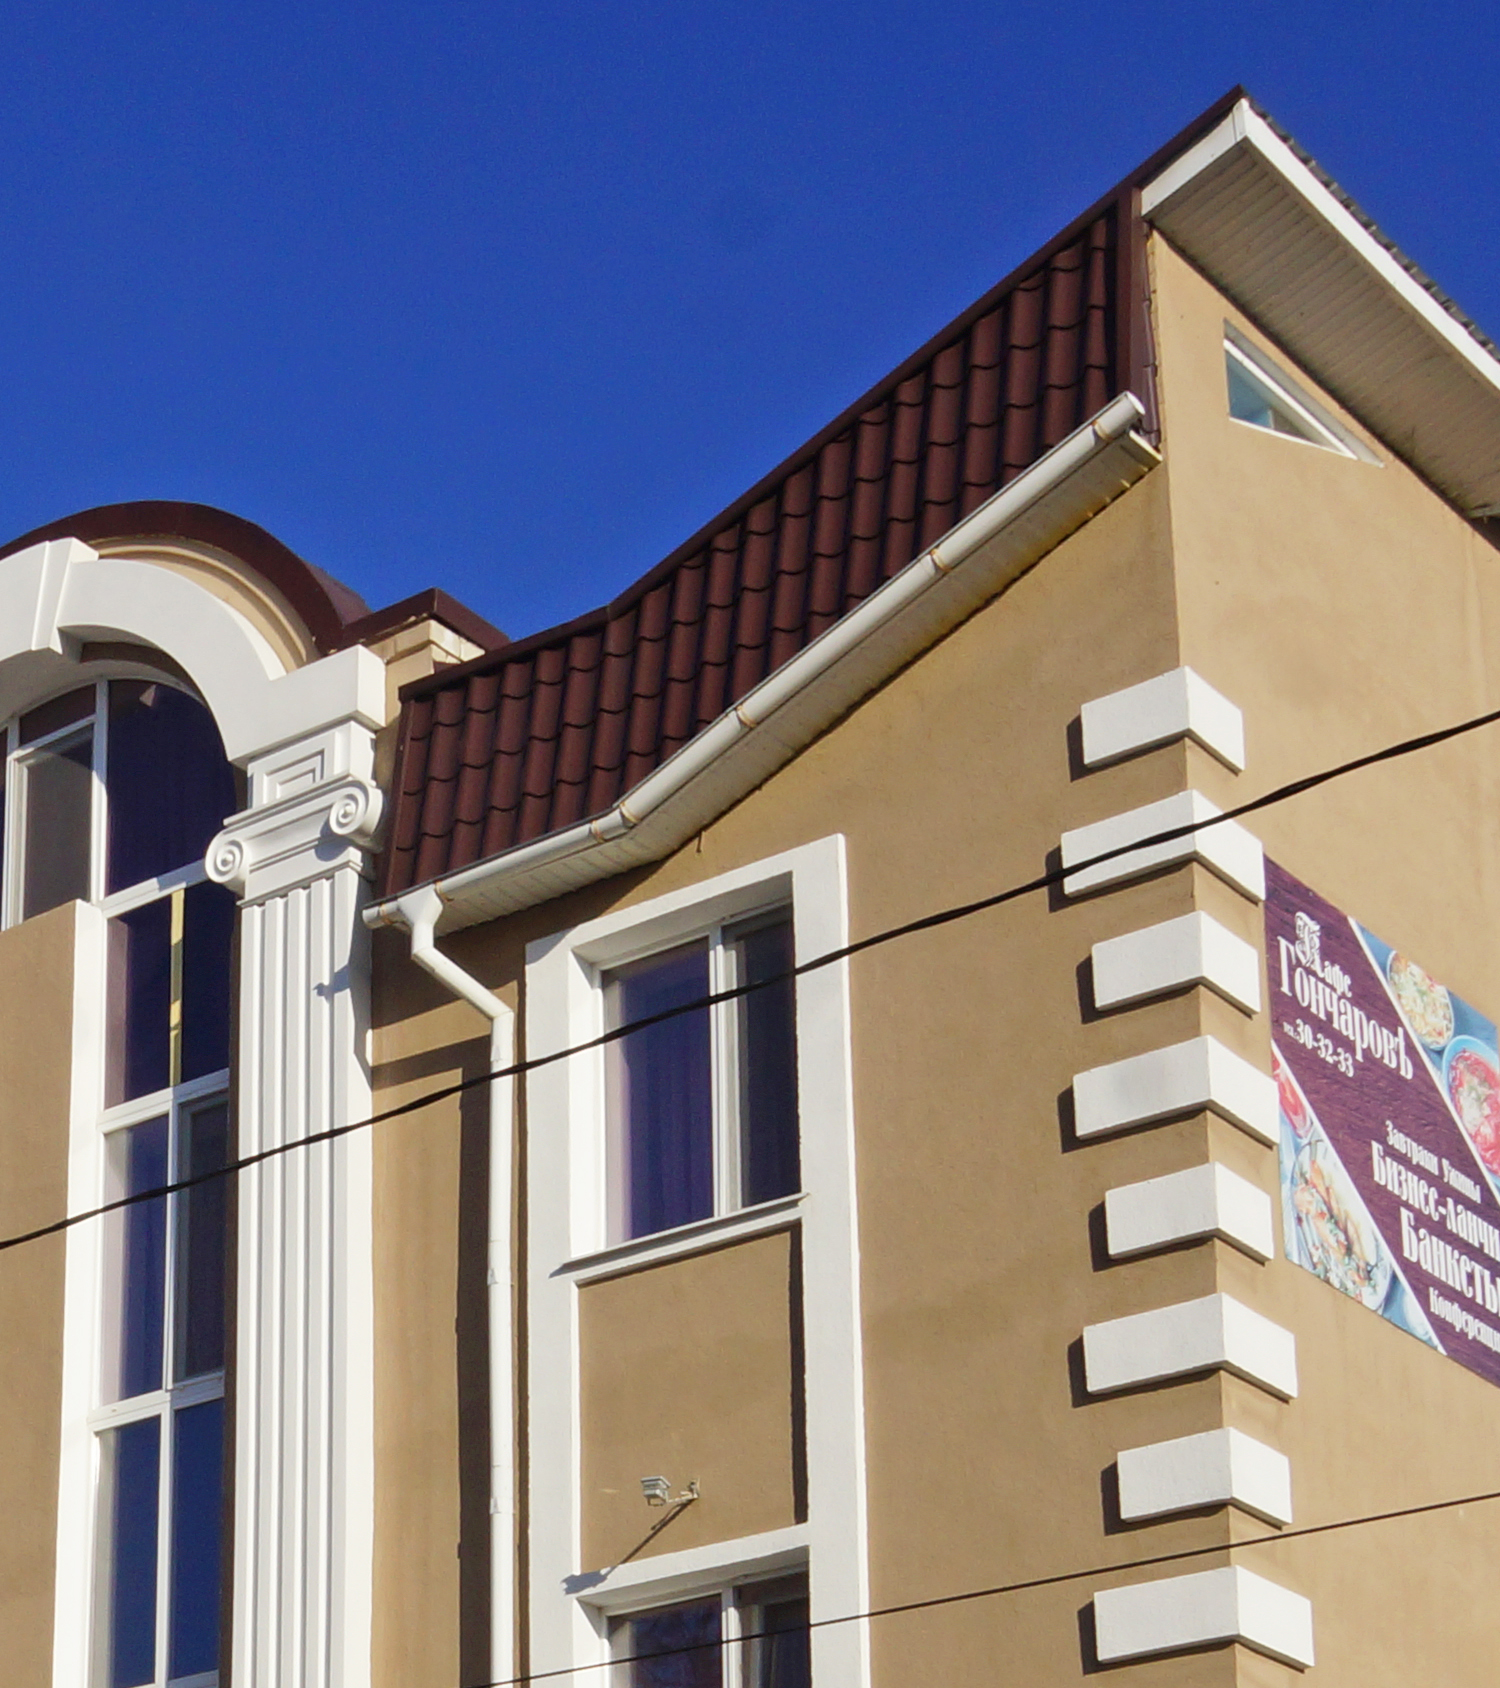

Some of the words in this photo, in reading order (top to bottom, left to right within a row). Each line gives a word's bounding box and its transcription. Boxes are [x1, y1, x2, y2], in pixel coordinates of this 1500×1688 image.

[1294, 911, 1353, 999] Кафе
[1276, 935, 1414, 1080] Гончаровъ
[1296, 1018, 1355, 1078] 30-32-33
[1385, 1119, 1439, 1177] Завтраки
[1441, 1157, 1482, 1204] Ужины
